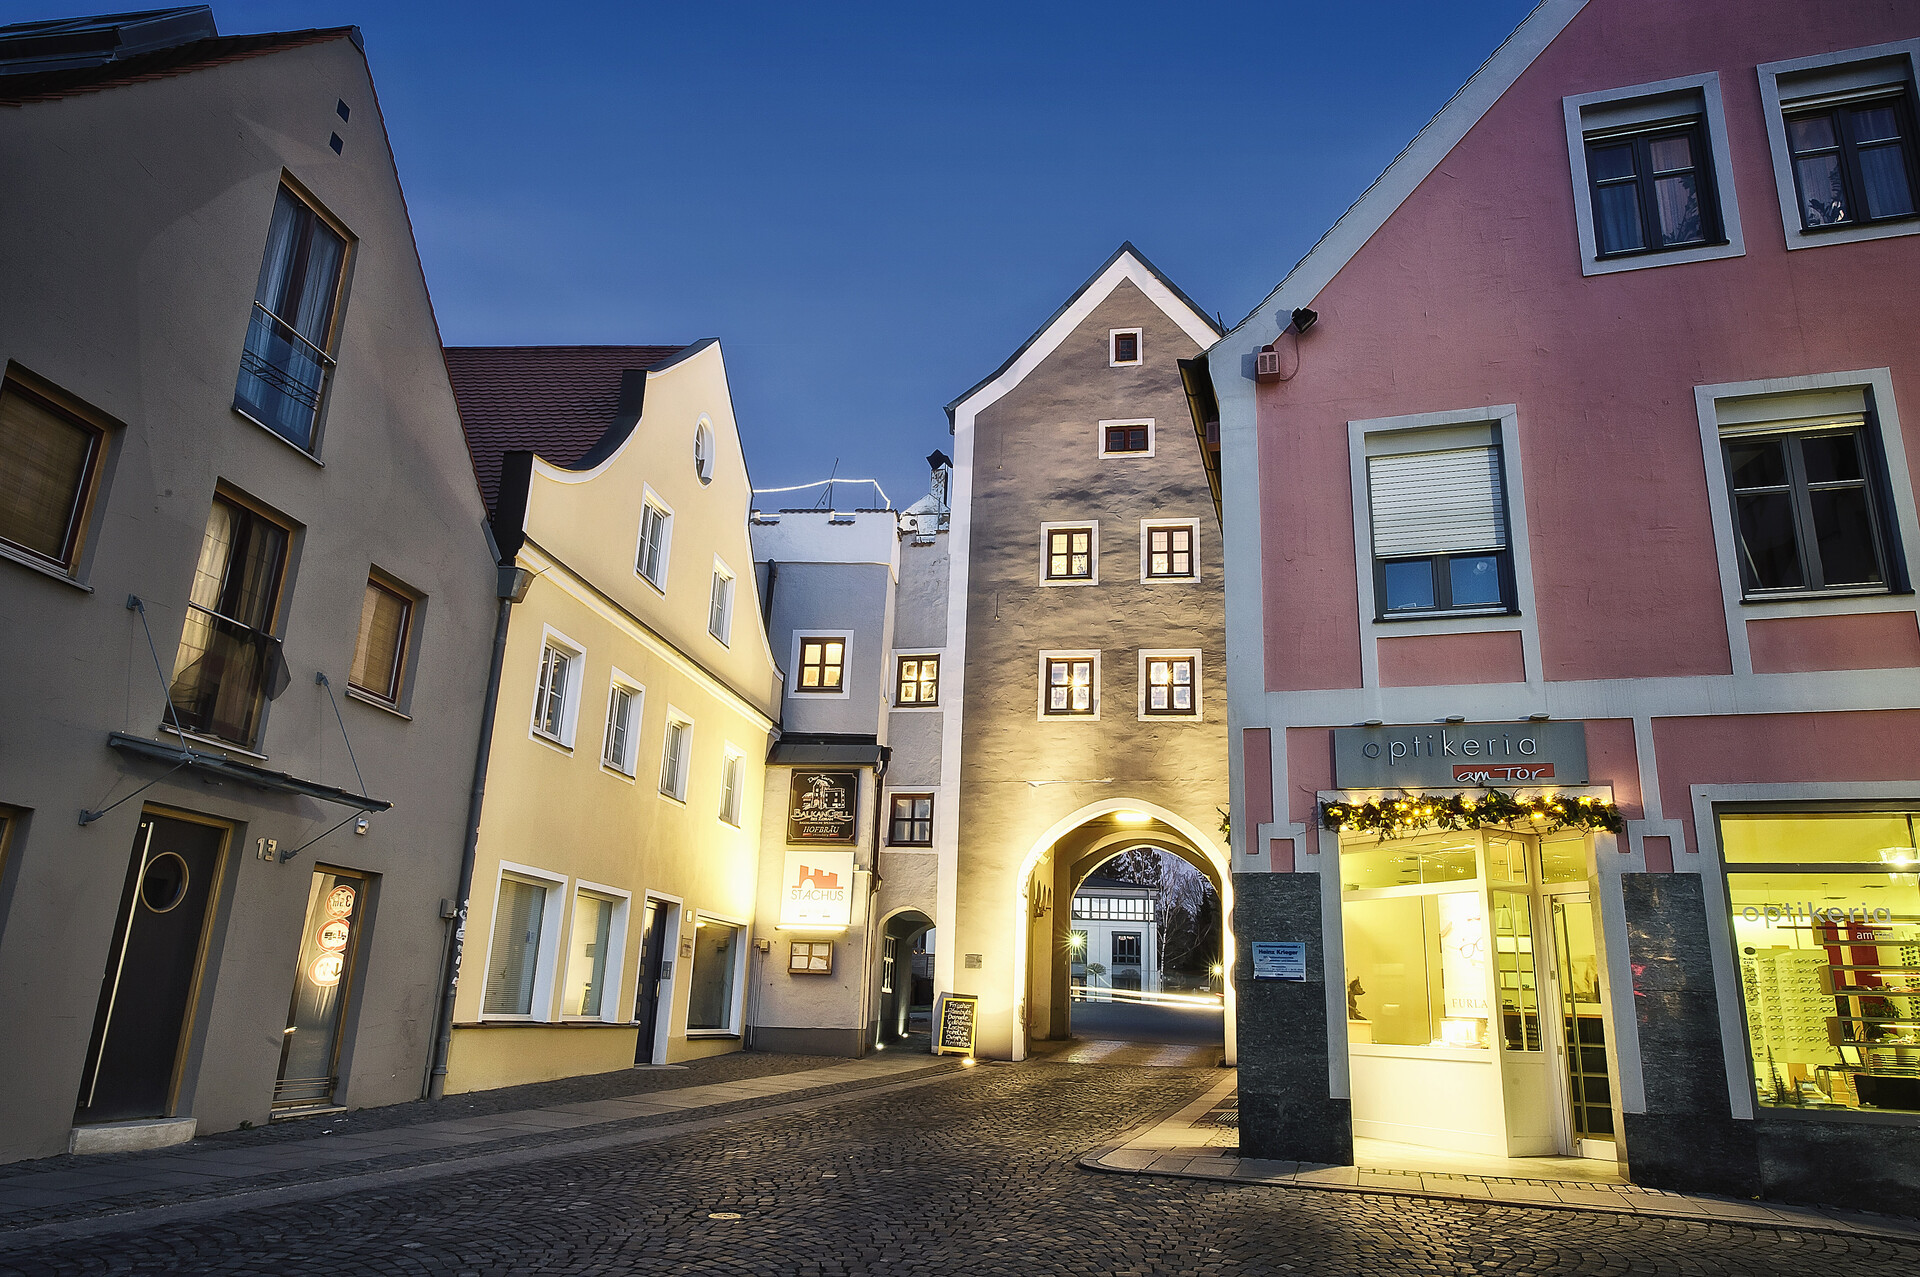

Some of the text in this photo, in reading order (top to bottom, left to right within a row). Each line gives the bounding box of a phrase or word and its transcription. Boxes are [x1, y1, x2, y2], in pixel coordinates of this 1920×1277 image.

[1362, 729, 1538, 766] optikeria
[1456, 771, 1491, 784] am
[802, 825, 840, 834] HOFBRÄU
[257, 837, 278, 861] 13
[791, 889, 844, 901] STACHUS
[1742, 901, 1892, 929] optikeria
[1856, 931, 1873, 940] am
[1451, 998, 1489, 1009] FURLA
